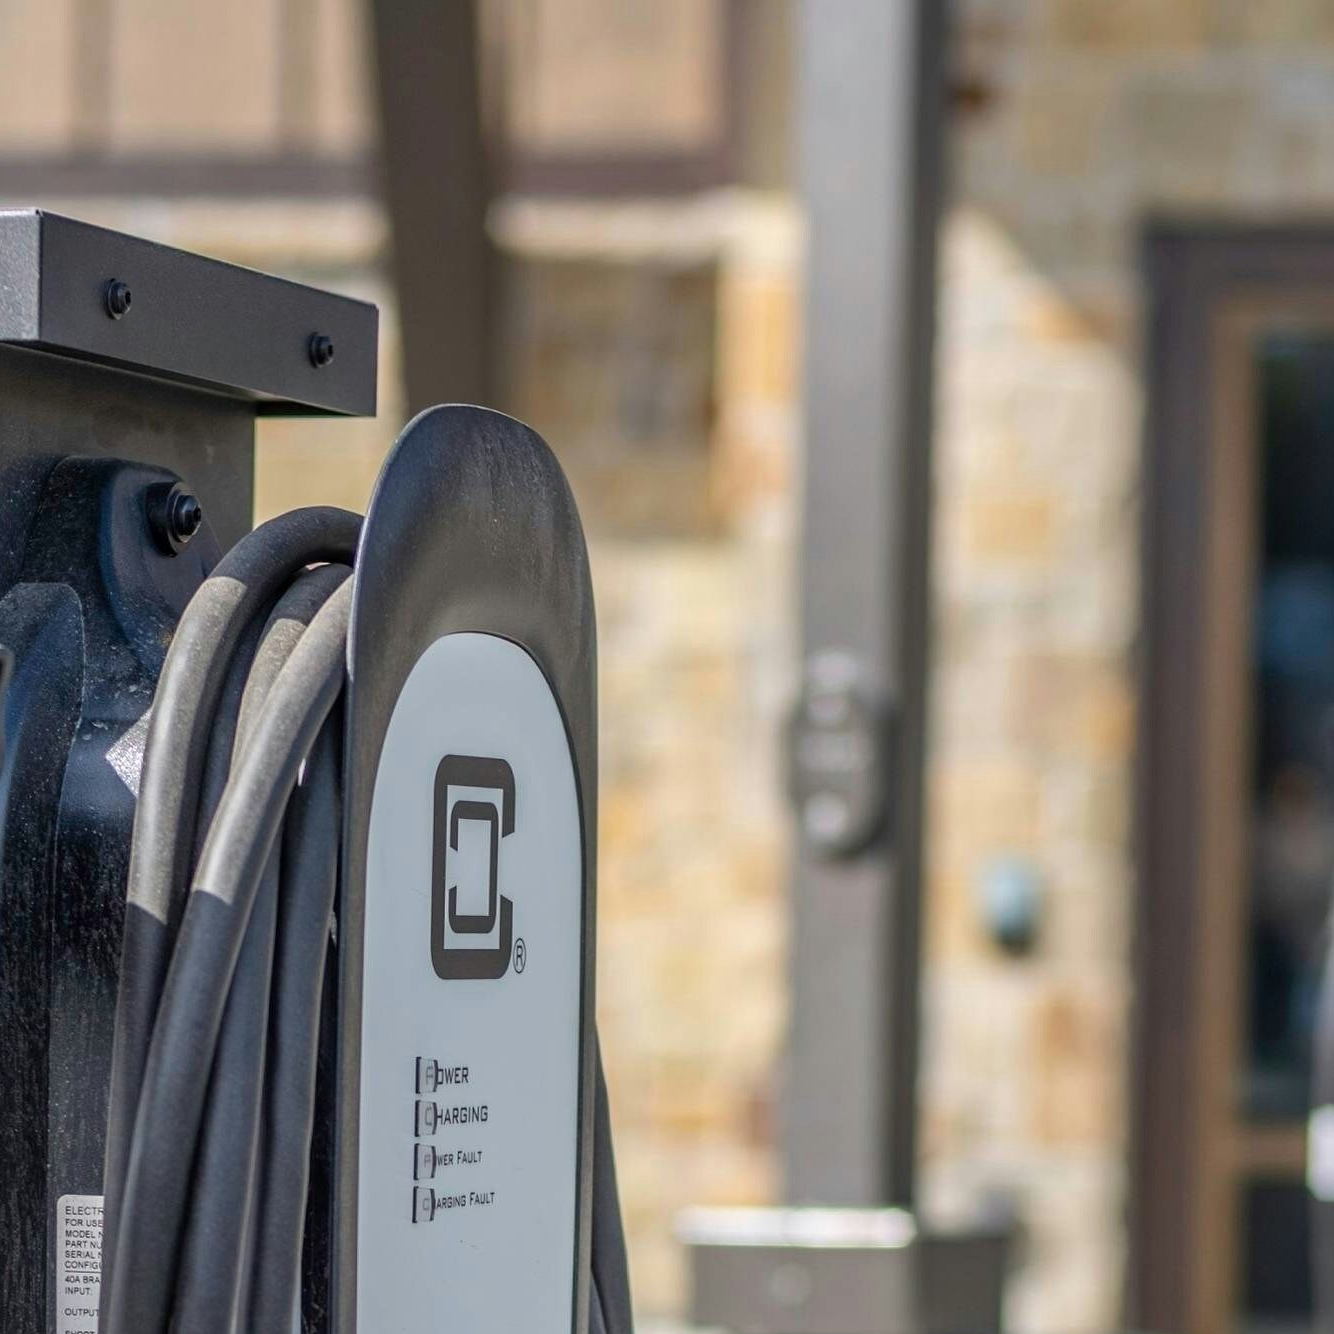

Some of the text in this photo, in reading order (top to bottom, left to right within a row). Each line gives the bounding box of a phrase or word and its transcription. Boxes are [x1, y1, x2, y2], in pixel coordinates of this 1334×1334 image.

[424, 1150, 483, 1168] PWER FAULT
[422, 1191, 495, 1211] CARGING FAULT
[65, 1218, 83, 1227] FOR
[65, 1230, 95, 1239] MODEL
[65, 1240, 87, 1249] PART
[65, 1250, 95, 1259] SERIAL
[65, 1260, 101, 1269] CONFIG
[64, 1275, 80, 1283] 40A
